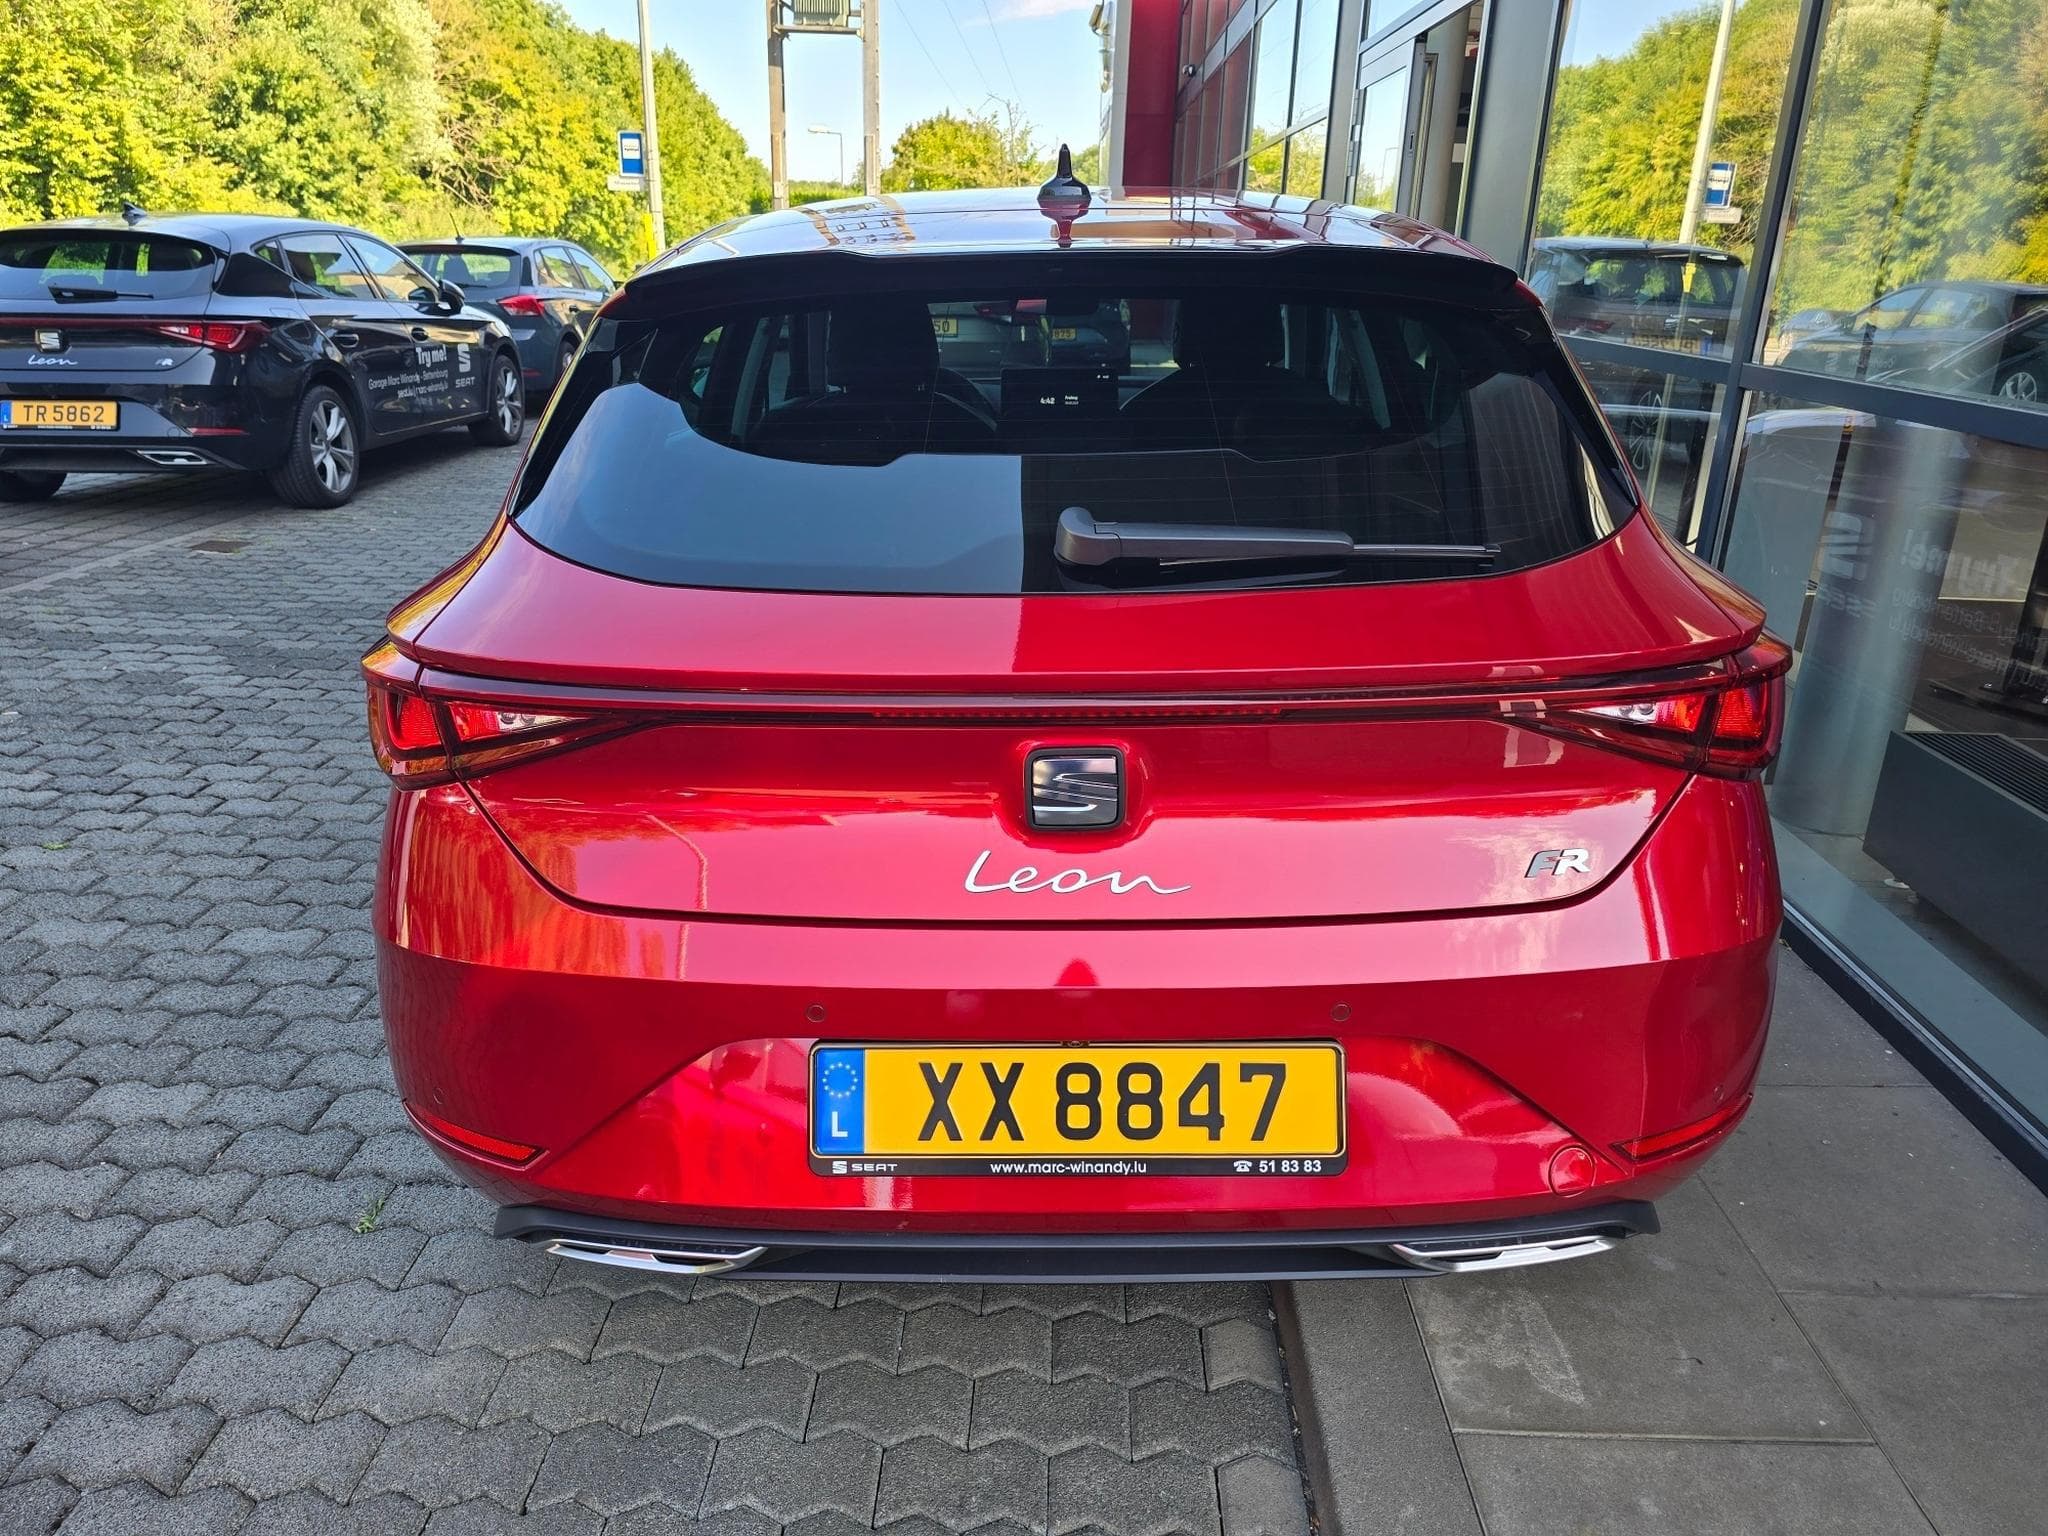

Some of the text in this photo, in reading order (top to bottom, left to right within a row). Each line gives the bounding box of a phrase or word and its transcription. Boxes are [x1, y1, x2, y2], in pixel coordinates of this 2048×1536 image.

[27, 354, 79, 366] Leon
[415, 343, 448, 368] Try me!
[368, 378, 388, 390] Garage
[455, 376, 476, 389] SEAT
[23, 405, 105, 423] TR 5862
[1523, 847, 1592, 879] FR
[963, 849, 1193, 895] Leon
[917, 1062, 1287, 1142] XX 8847
[831, 1110, 848, 1138] L
[851, 1163, 898, 1172] SEAT
[989, 1160, 1147, 1176] www.marc-winandy.lu
[1258, 1159, 1322, 1173] 51 83 83
